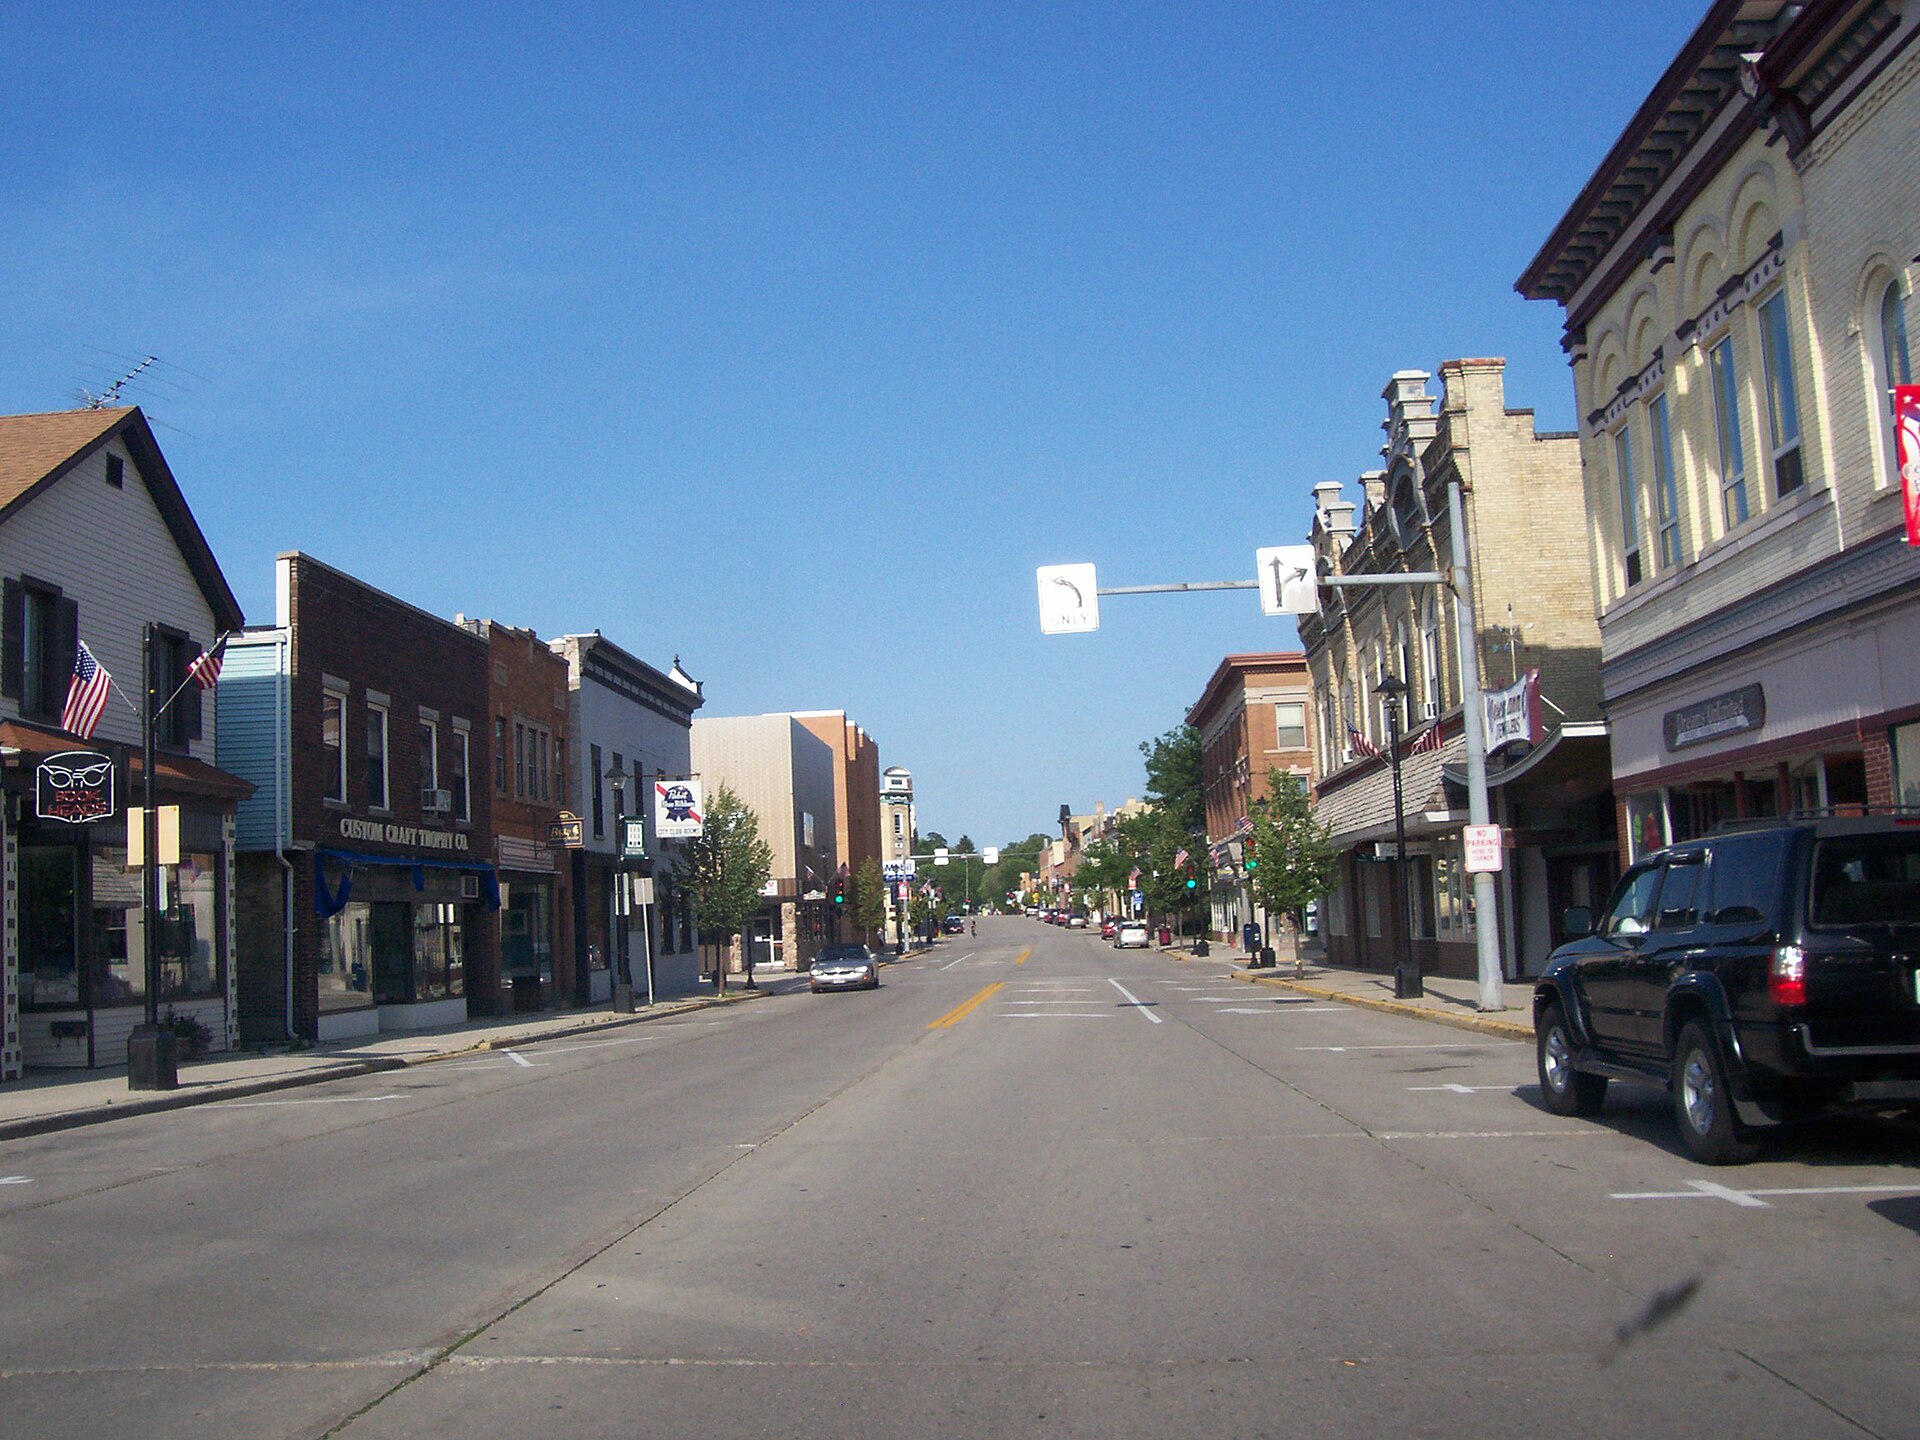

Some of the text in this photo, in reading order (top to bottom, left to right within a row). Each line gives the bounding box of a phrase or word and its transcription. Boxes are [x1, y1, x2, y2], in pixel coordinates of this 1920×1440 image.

[54, 789, 103, 802] BOOK
[668, 789, 688, 799] Pabst
[340, 818, 384, 842] CUSTOM
[385, 824, 418, 846] CRAFT
[418, 828, 454, 849] TROPHY
[658, 828, 668, 836] CITY
[670, 828, 682, 836] CLUB
[1476, 829, 1487, 837] NO
[1466, 839, 1498, 847] PARKING
